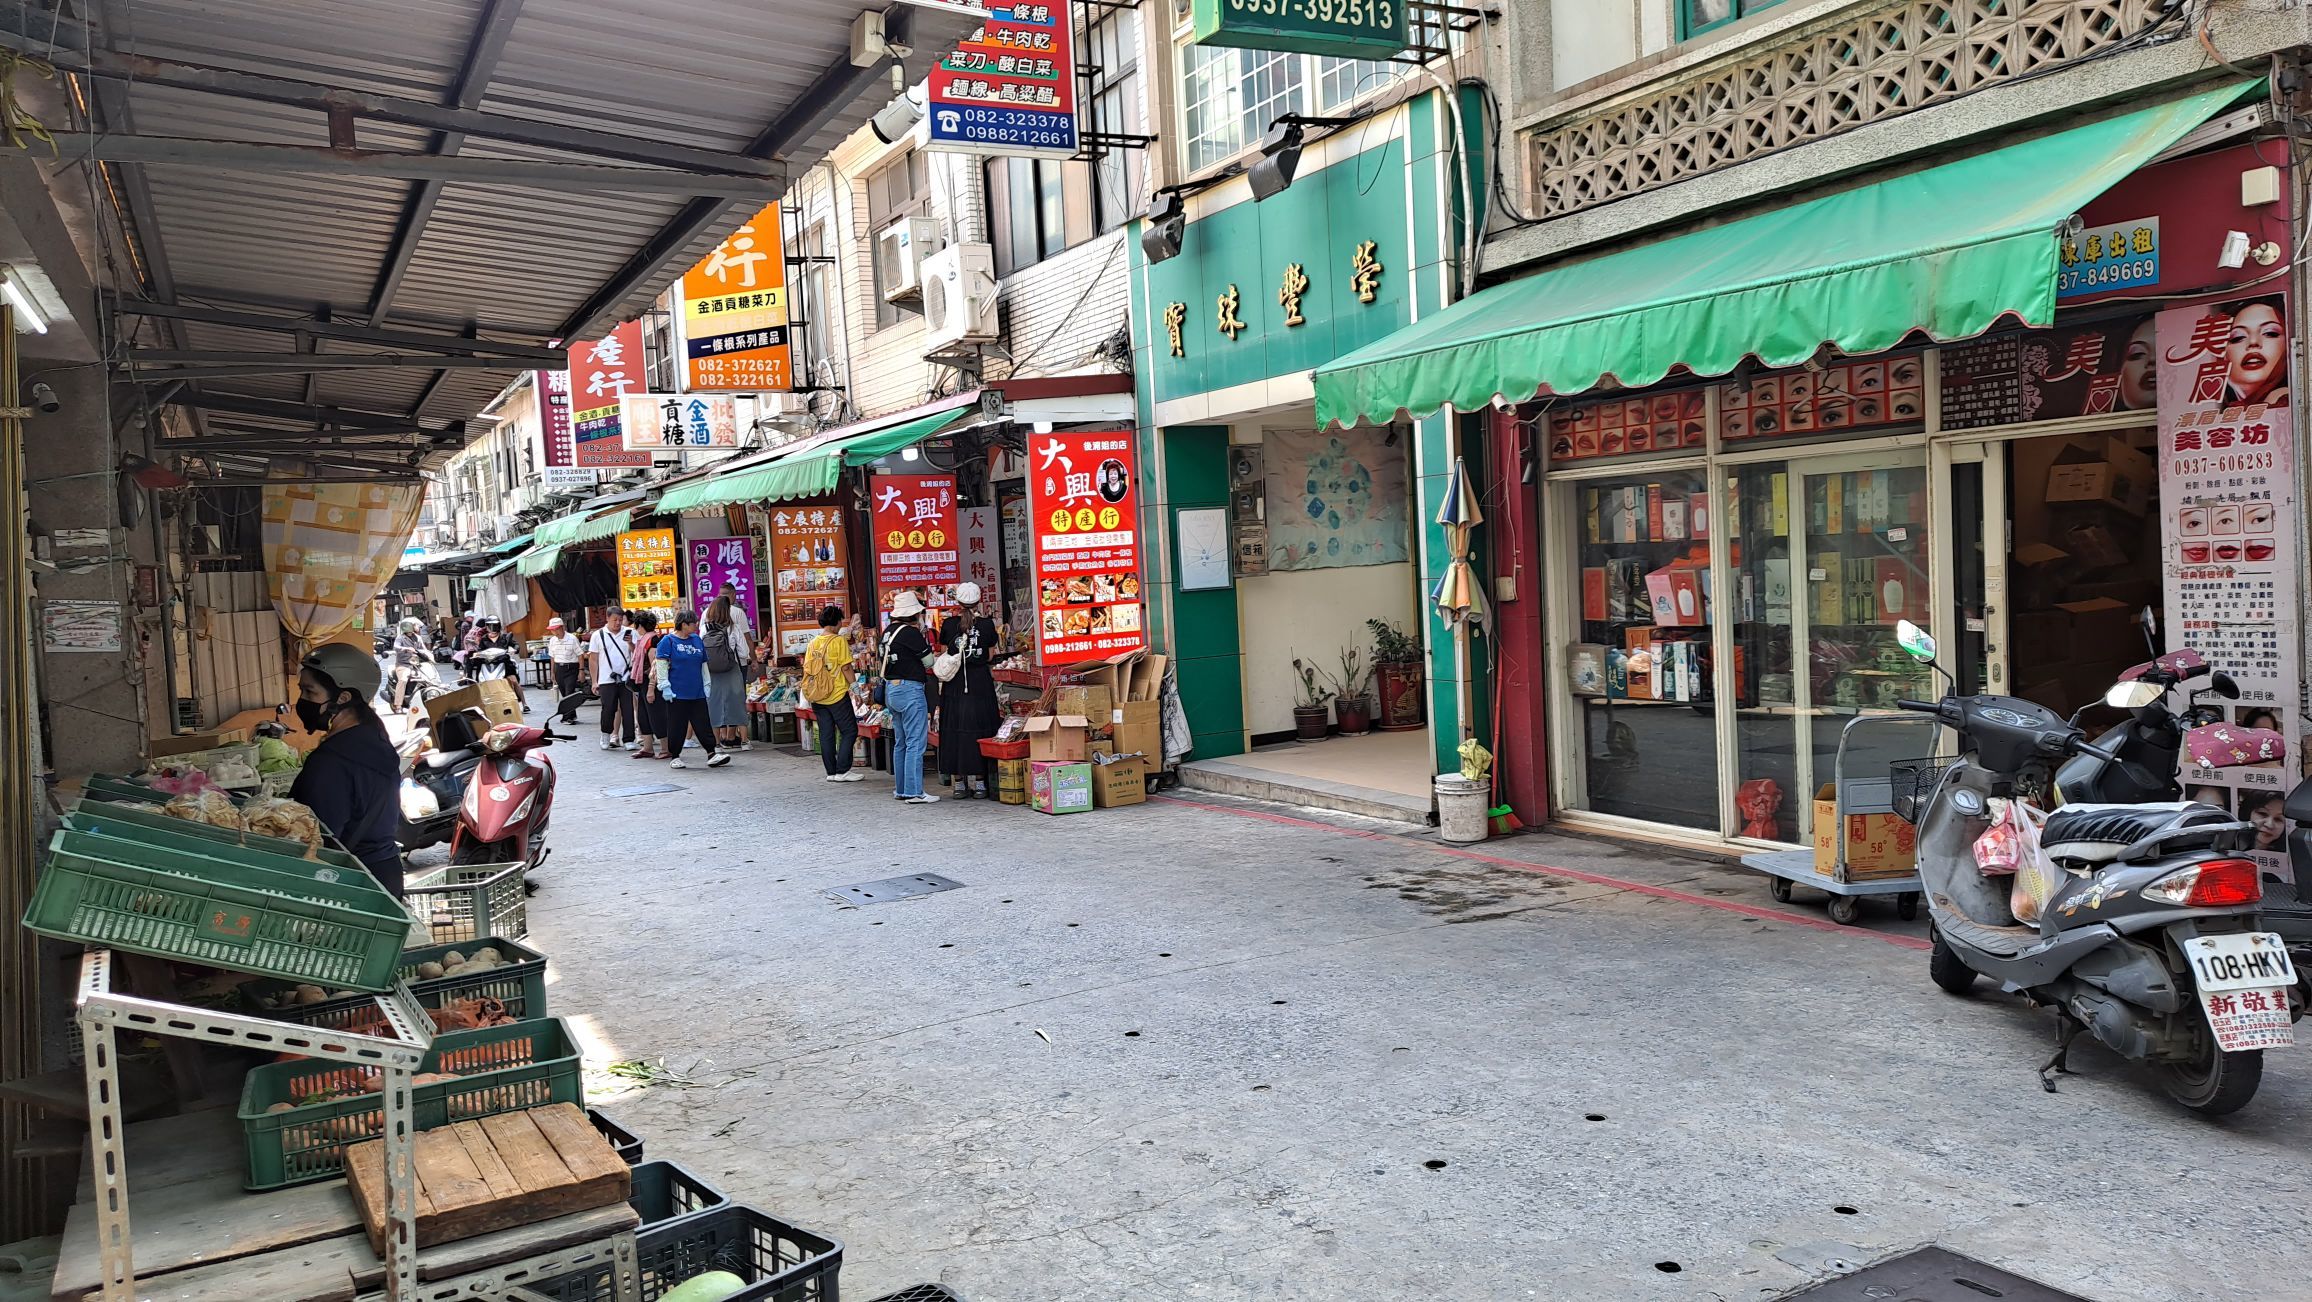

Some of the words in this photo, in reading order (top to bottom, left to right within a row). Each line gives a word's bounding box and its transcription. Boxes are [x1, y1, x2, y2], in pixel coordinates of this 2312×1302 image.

[965, 109, 1069, 129] 082-323378
[966, 126, 1069, 145] 0988212661
[698, 293, 776, 314] 金酒貢糖菜刀
[701, 331, 780, 352] 一條根系列產品
[698, 359, 781, 371] 082-372627
[700, 374, 781, 386] 082-322161
[660, 399, 685, 445] 貢糖
[686, 399, 710, 445] 金酒
[2174, 423, 2270, 451] 美容坊
[1038, 438, 1097, 507] 大興
[2174, 452, 2273, 476] 0937-606283
[875, 485, 943, 527] 大興
[773, 510, 843, 527] 金展特產
[1054, 510, 1117, 527] 特產行
[890, 532, 943, 546] 特產行
[2242, 691, 2275, 701] 使用後
[2192, 769, 2223, 780] 使用前
[2244, 773, 2278, 785] 使用後
[2208, 990, 2288, 1017] 新敬業
